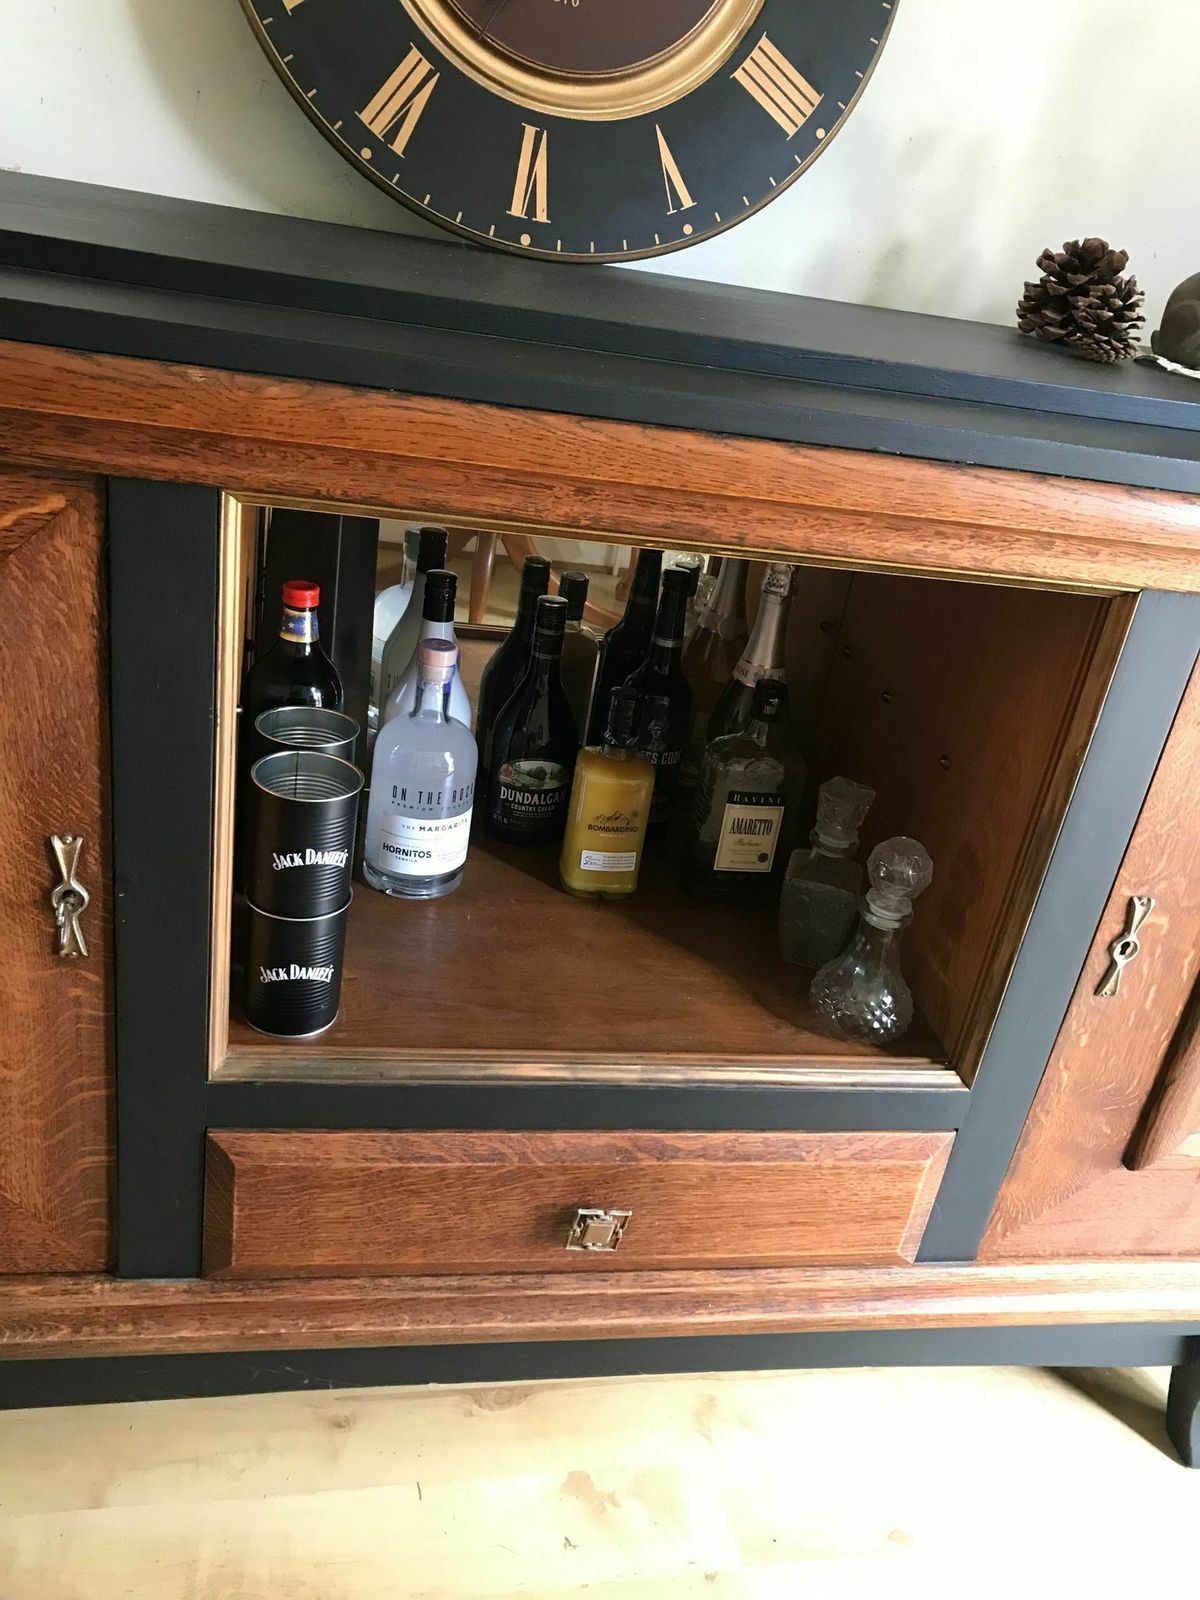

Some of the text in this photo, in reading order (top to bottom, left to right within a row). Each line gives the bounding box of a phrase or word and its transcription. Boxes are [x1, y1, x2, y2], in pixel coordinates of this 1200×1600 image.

[392, 785, 407, 802] ON
[418, 791, 442, 805] THE
[402, 824, 416, 832] THE
[587, 823, 639, 834] BOMBARDINO
[728, 816, 773, 837] AMARETTO
[382, 841, 433, 859] HORNITOS
[272, 851, 304, 870] JACK
[260, 964, 288, 984] JACK
